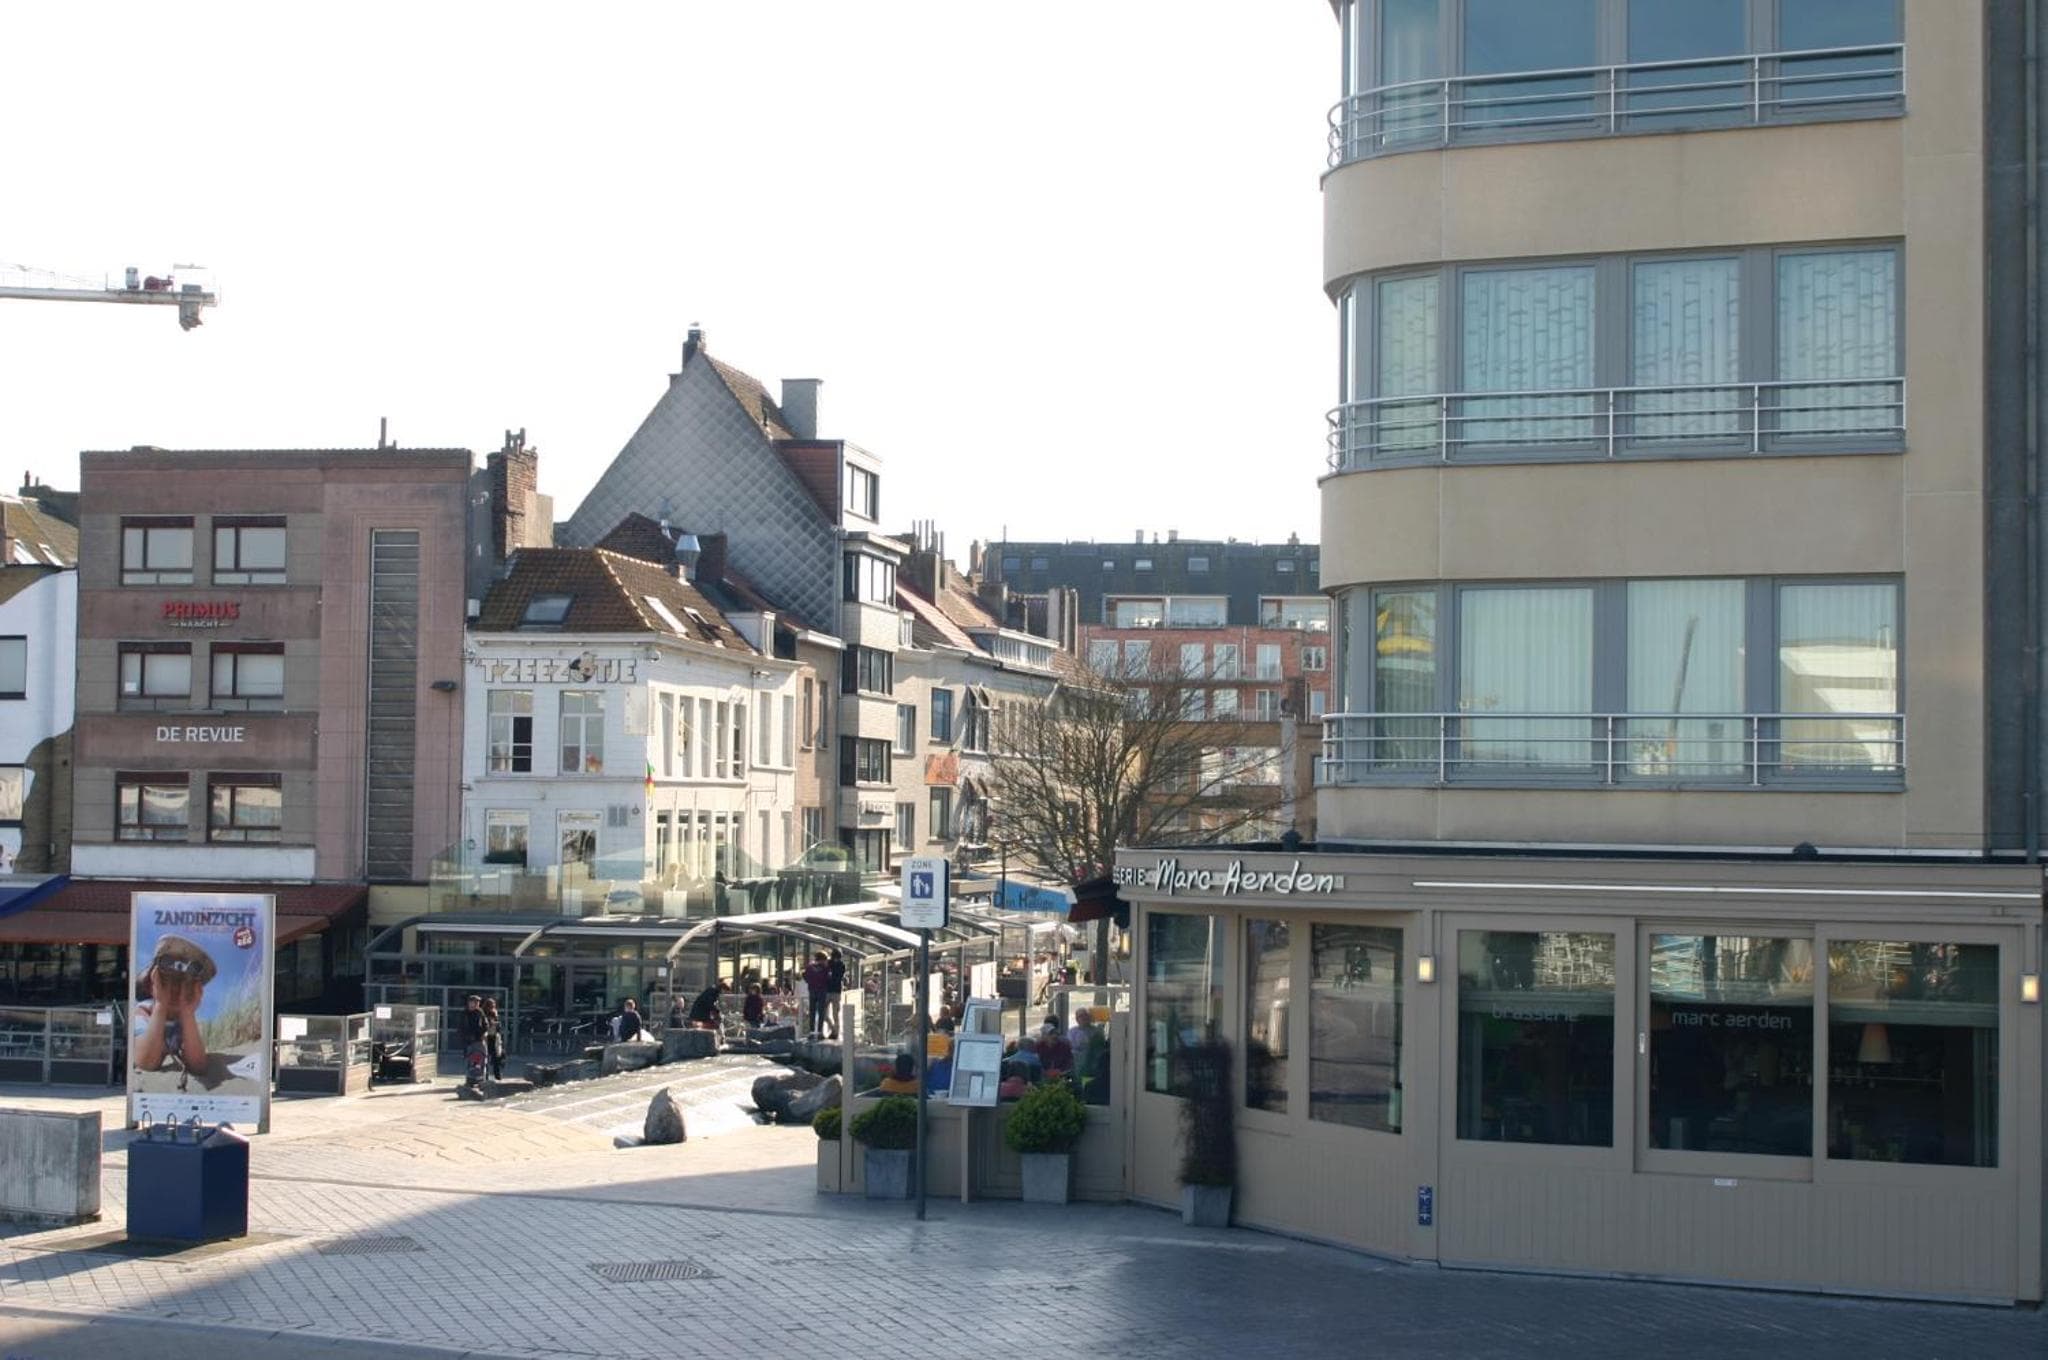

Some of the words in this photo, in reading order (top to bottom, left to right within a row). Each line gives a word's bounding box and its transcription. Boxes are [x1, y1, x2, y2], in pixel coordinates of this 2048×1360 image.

[162, 600, 239, 619] PRIMUS
[156, 726, 181, 742] DE
[186, 726, 245, 742] REVUE
[1155, 858, 1213, 896] Marc
[1222, 859, 1334, 896] Aerden
[154, 910, 257, 927] ZANDINZICHT
[1672, 1011, 1720, 1026] marc
[1724, 1010, 1793, 1029] aerden
